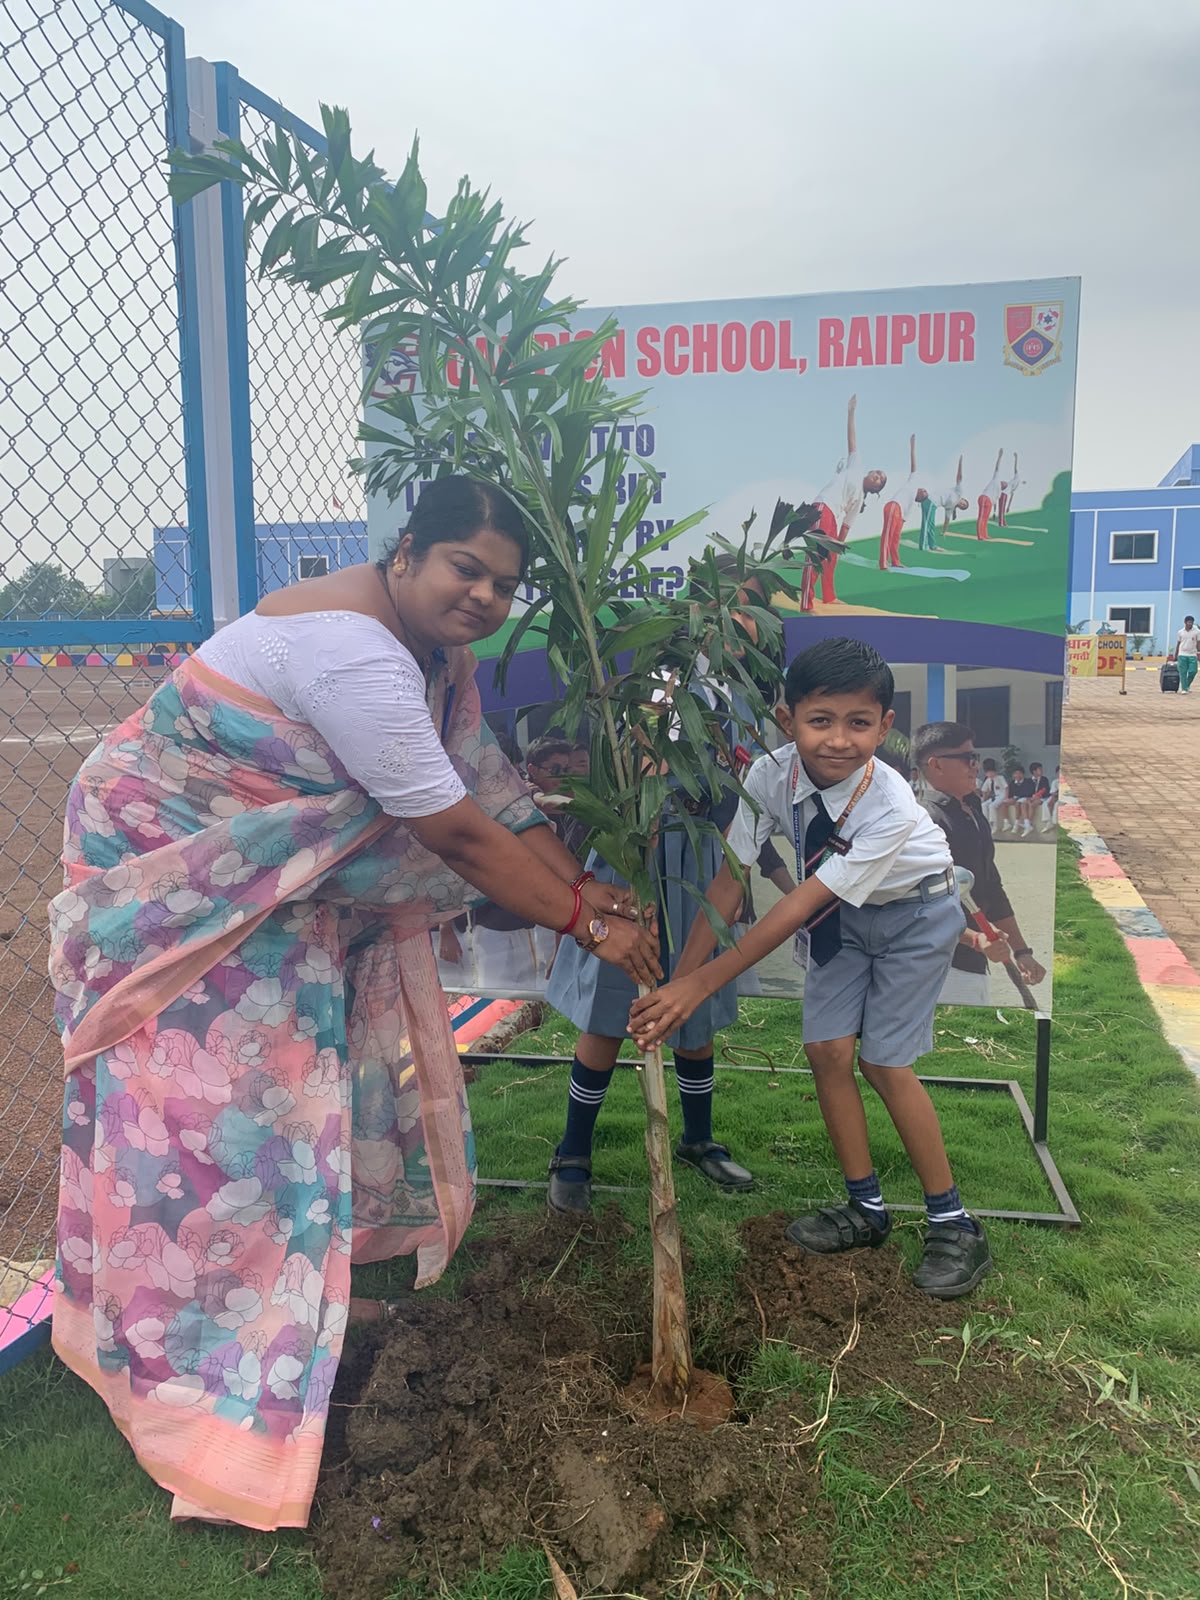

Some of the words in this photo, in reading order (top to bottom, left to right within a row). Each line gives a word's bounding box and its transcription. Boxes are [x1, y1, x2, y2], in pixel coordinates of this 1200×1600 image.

[637, 320, 807, 376] SCHOOL,
[818, 312, 976, 368] RAIPUR
[617, 424, 655, 457] TO
[636, 519, 674, 551] BY
[1097, 640, 1124, 649] CHOOL
